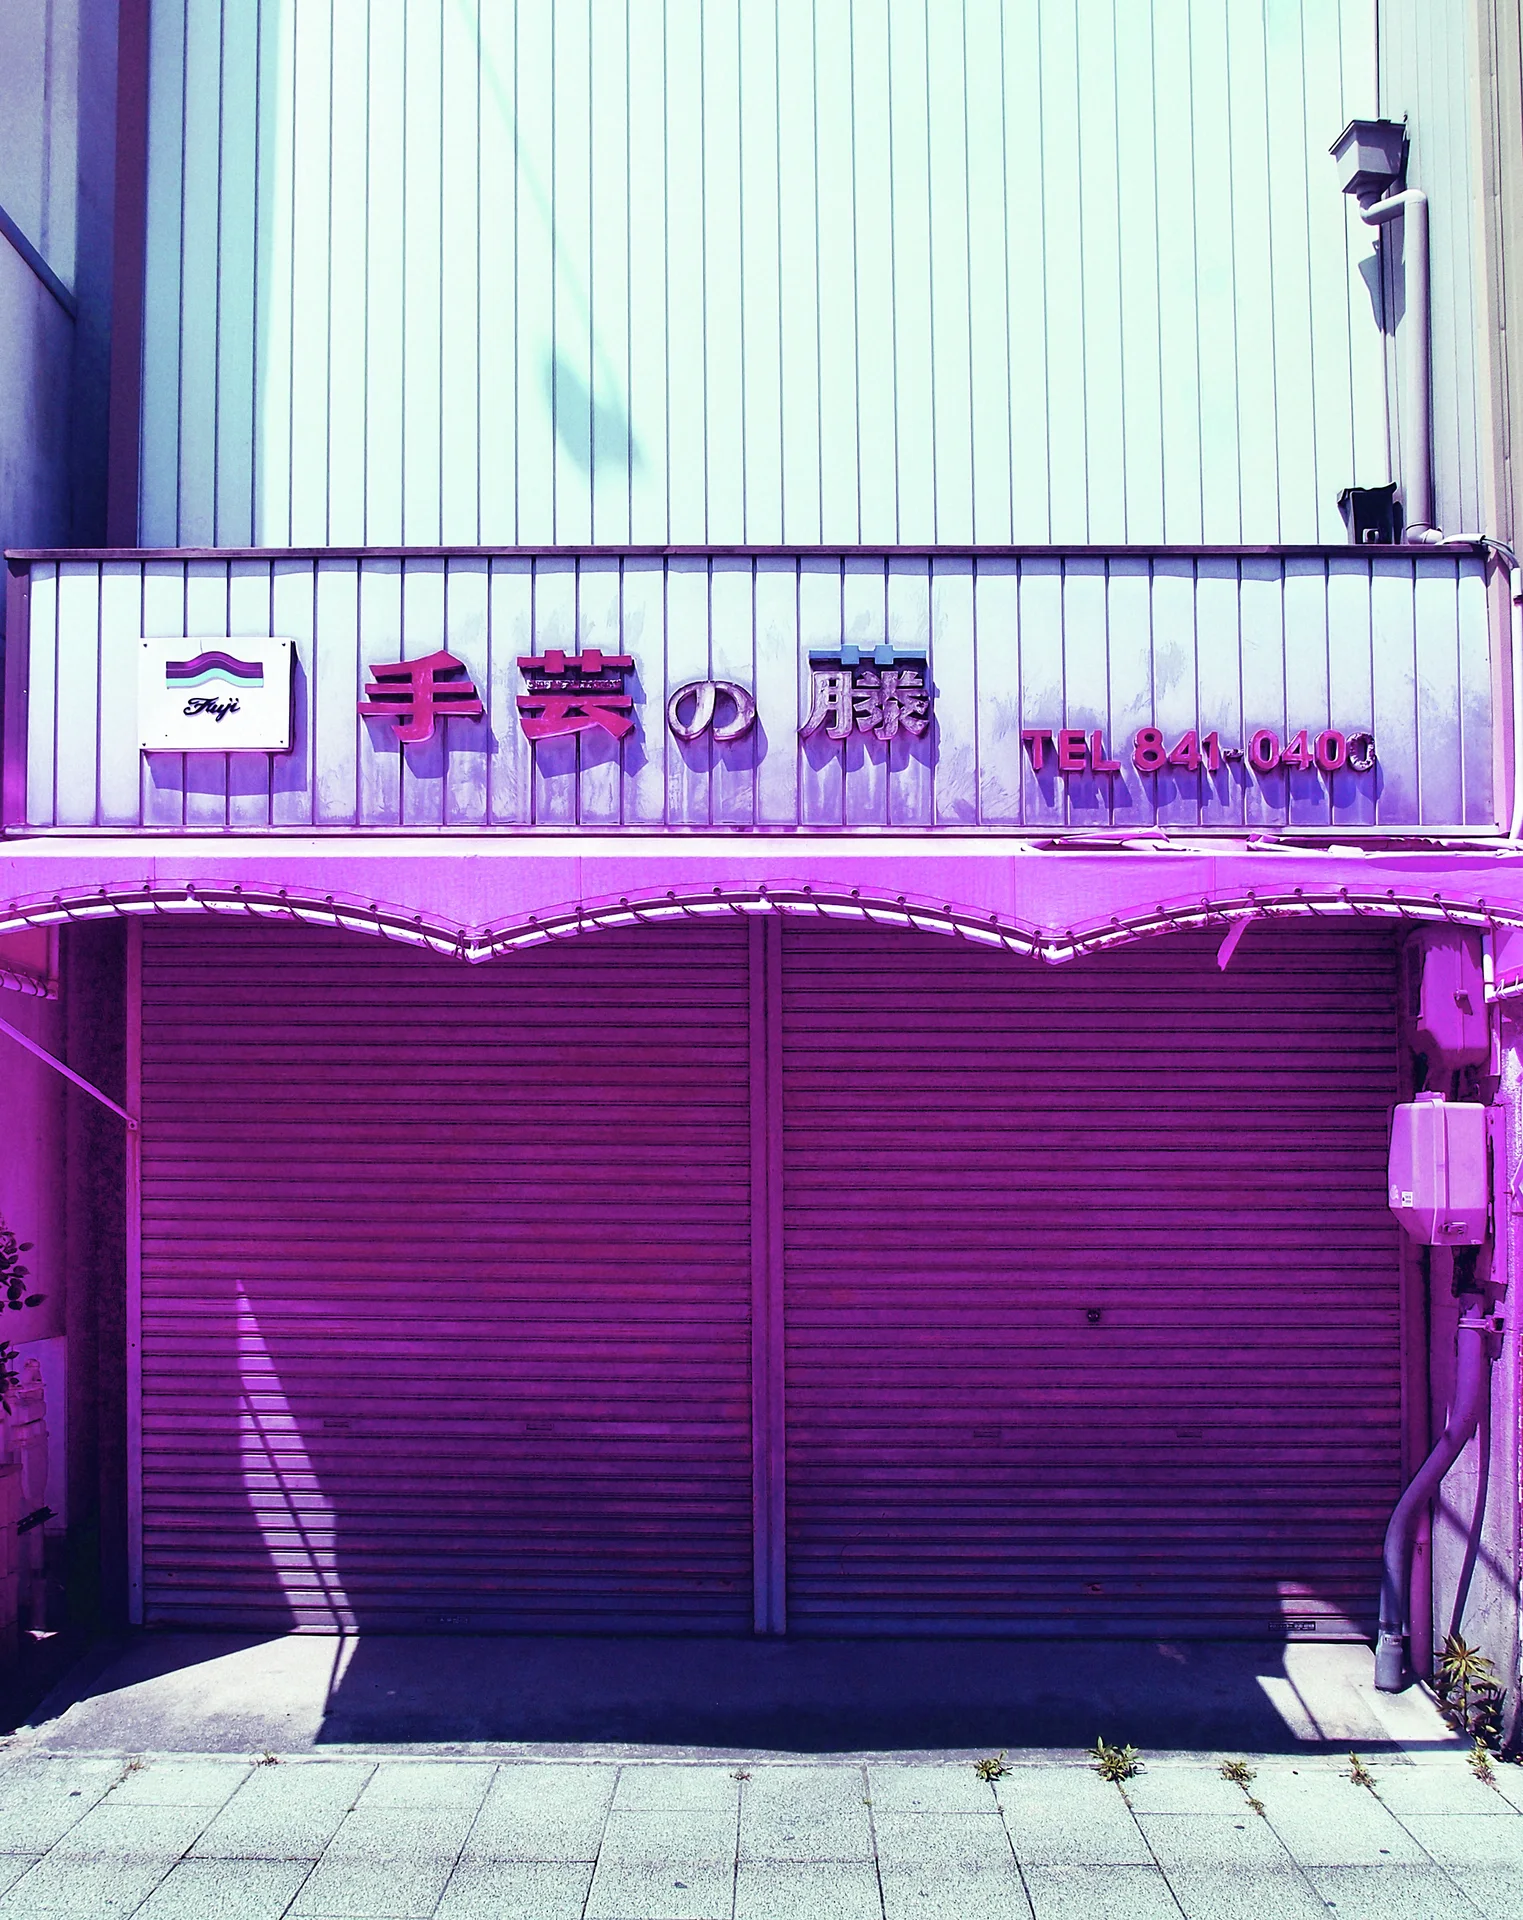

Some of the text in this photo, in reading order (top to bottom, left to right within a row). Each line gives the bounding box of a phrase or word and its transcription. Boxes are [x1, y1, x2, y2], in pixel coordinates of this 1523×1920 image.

[183, 696, 241, 723] Fuji
[357, 644, 932, 744] 手芸の藤
[1022, 726, 1376, 772] TEL 841-0400
